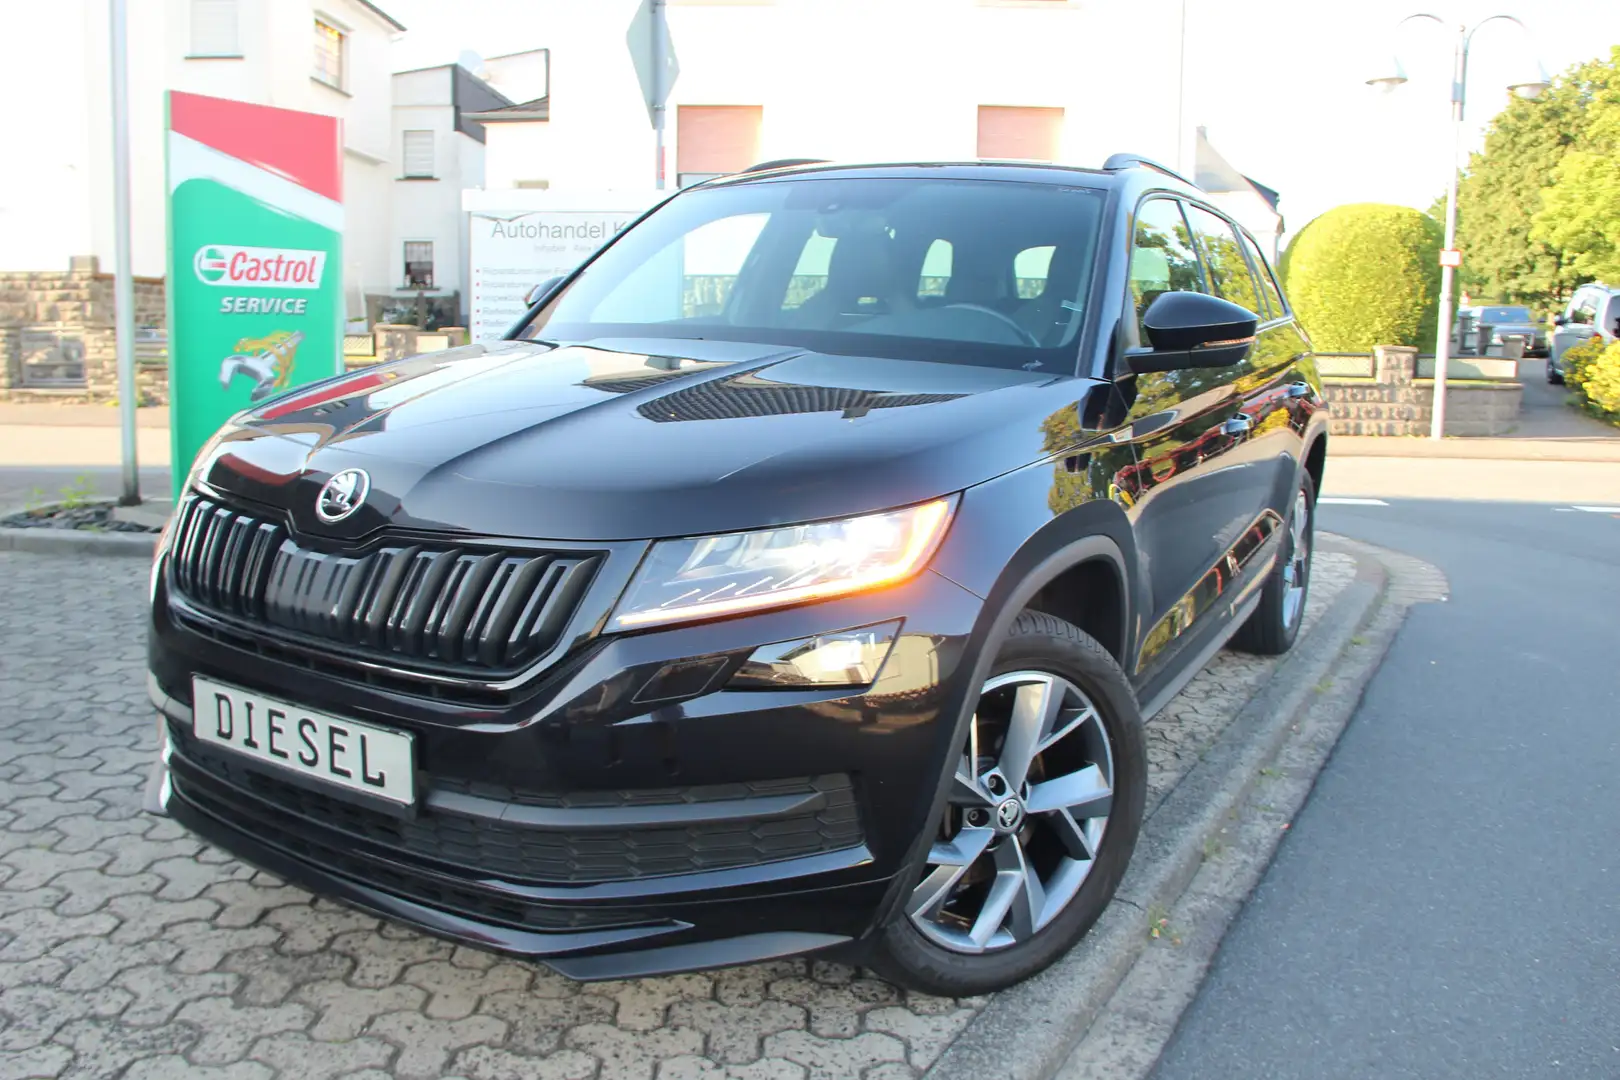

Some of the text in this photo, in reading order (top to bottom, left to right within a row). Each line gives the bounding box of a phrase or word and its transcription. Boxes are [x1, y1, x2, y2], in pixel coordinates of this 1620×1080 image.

[491, 221, 605, 239] Autohandel
[229, 251, 317, 283] Castrol
[220, 296, 308, 315] SERVICE
[214, 693, 386, 787] DIESEL
